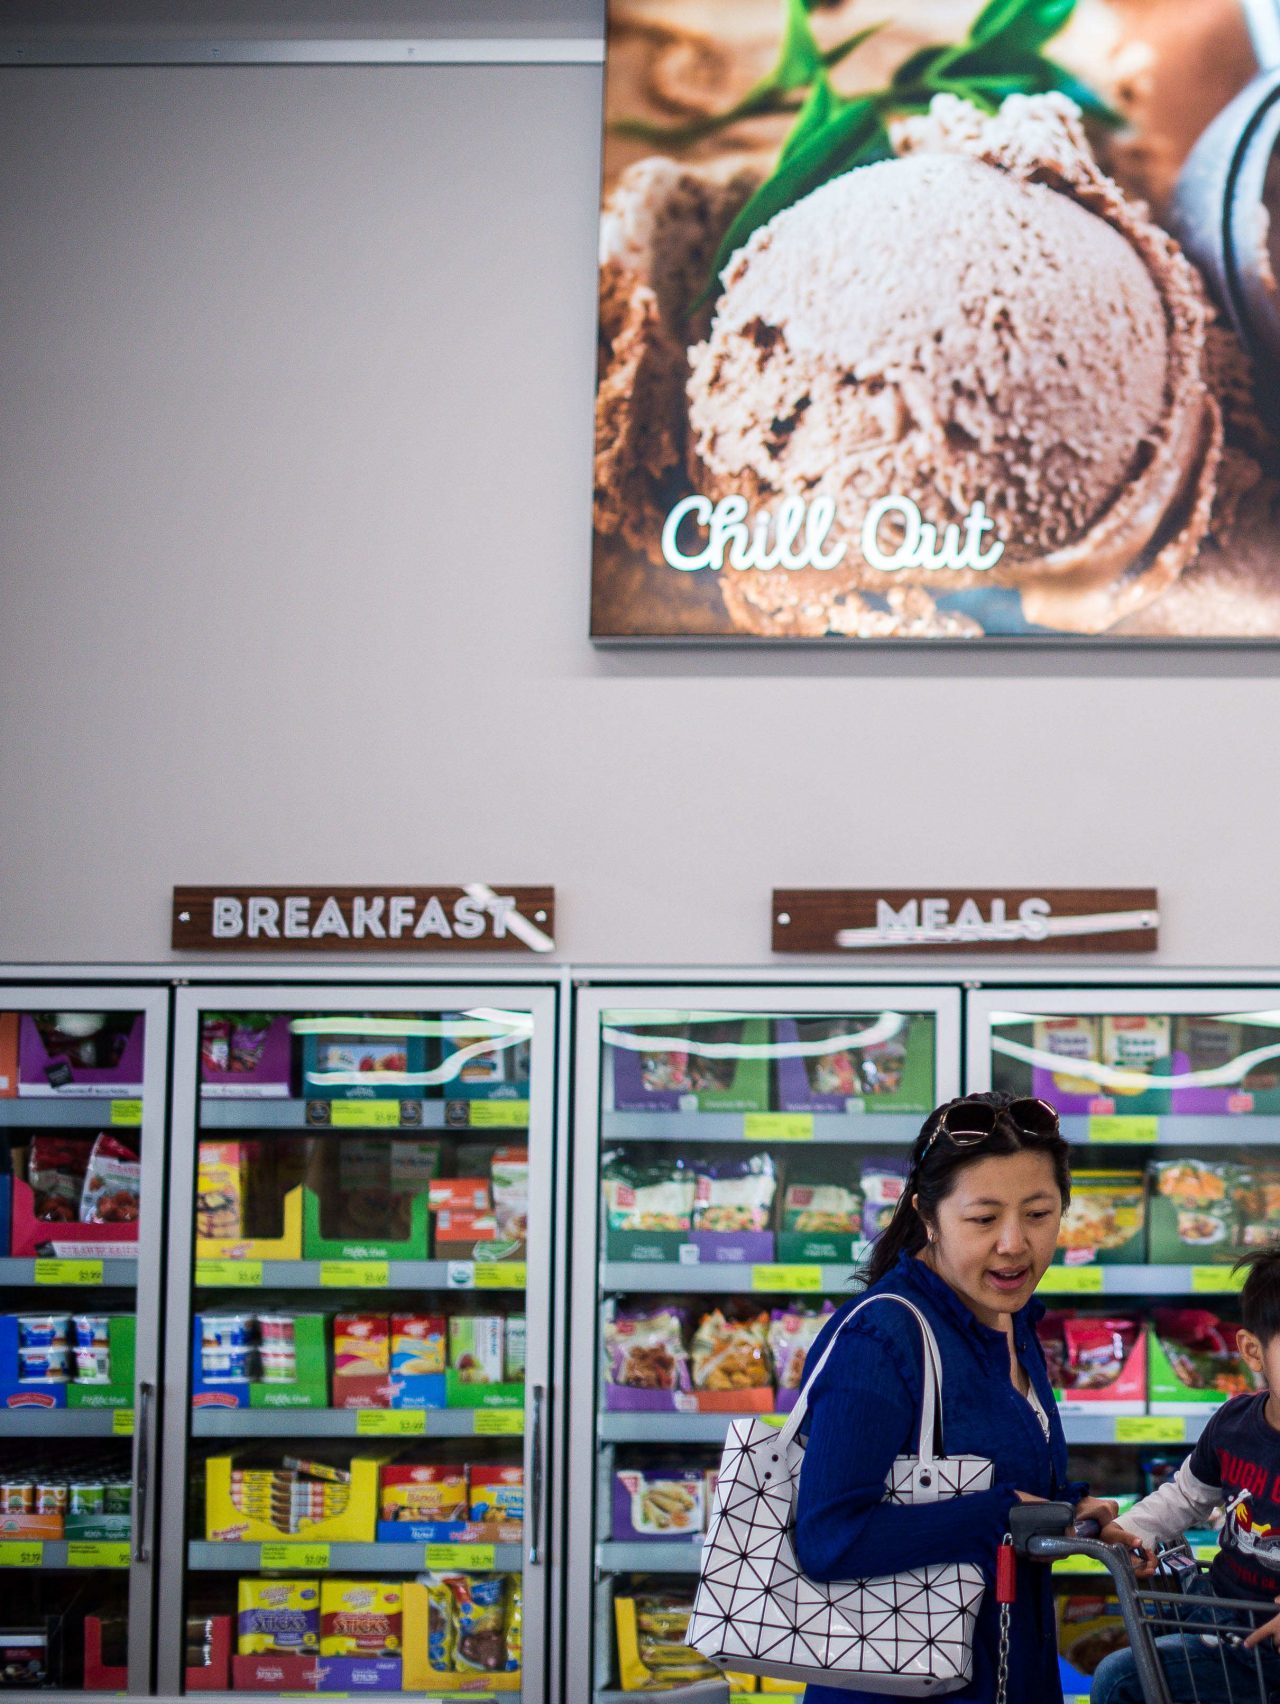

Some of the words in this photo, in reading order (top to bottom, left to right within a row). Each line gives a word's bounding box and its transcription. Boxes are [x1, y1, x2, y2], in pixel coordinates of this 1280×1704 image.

[661, 494, 847, 571] Chill
[861, 495, 1005, 571] Out
[212, 897, 516, 938] BREAKFAST
[875, 899, 1051, 943] MEALS
[1218, 1448, 1268, 1497] OUGH
[255, 1615, 307, 1633] STICKS
[334, 1619, 390, 1635] STICKS
